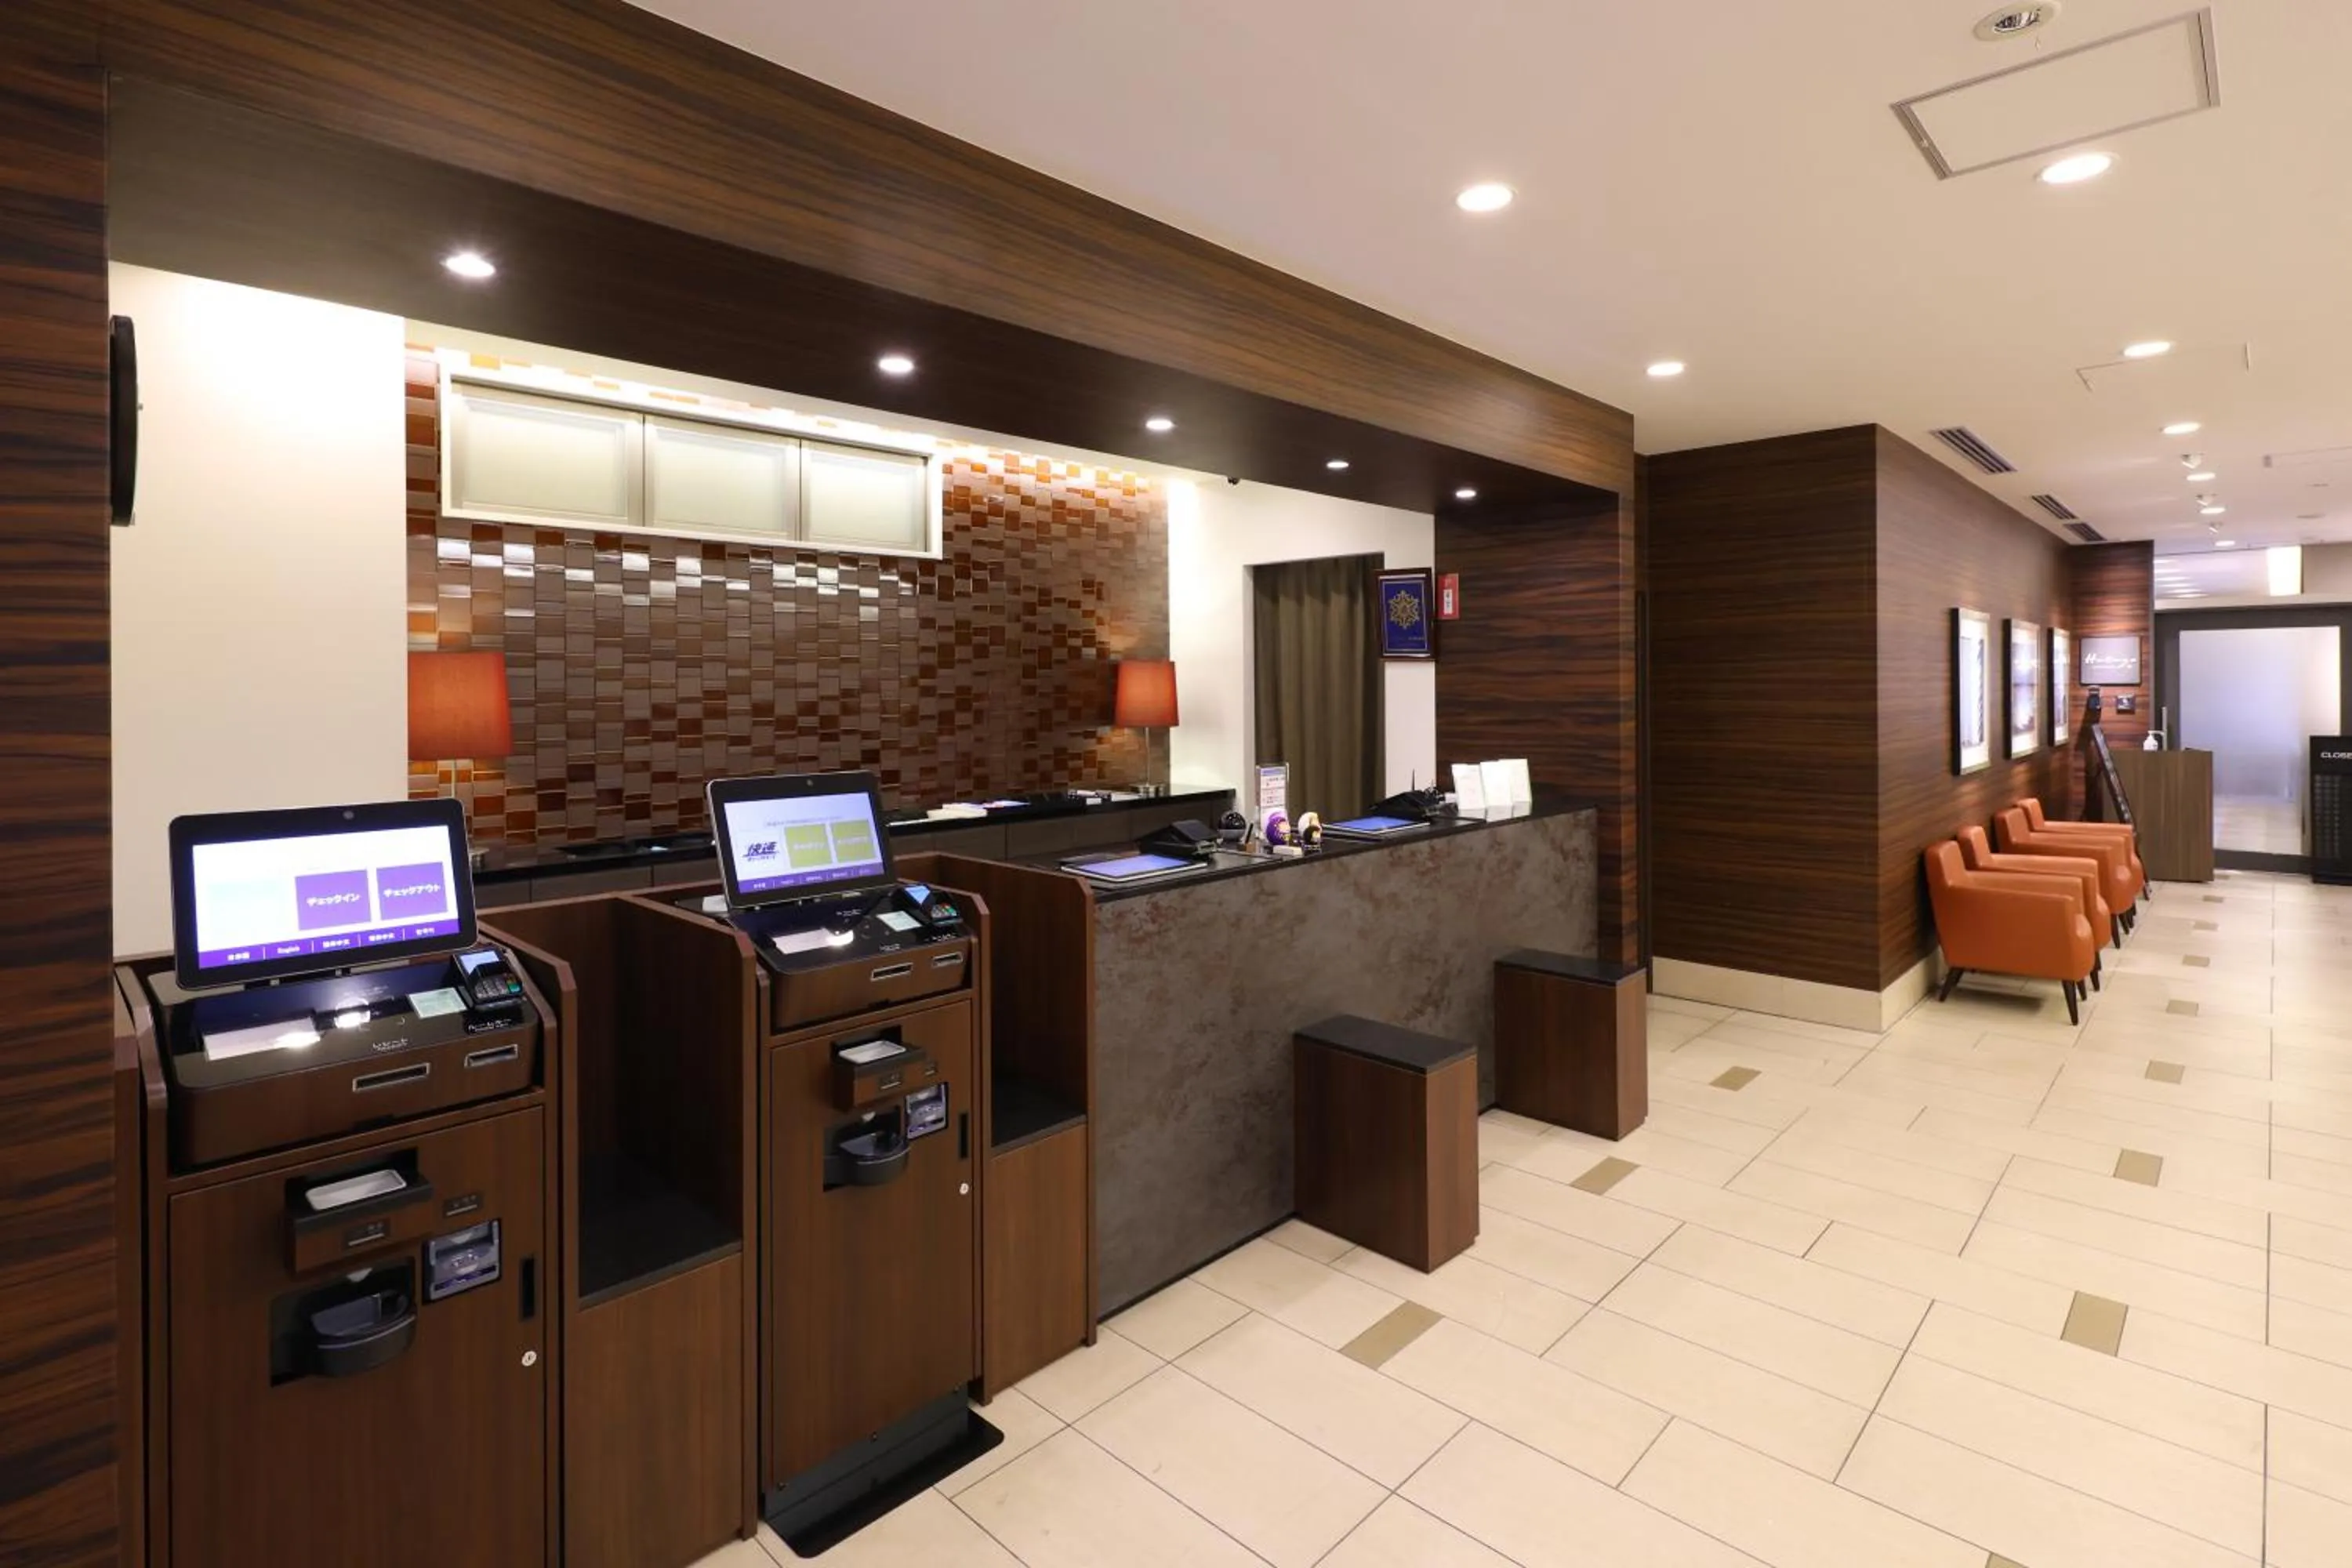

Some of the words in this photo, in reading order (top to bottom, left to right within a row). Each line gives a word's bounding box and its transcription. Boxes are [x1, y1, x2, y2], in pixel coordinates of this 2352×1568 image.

[383, 884, 441, 898] チェックアウト
[307, 893, 361, 907] チェックイン
